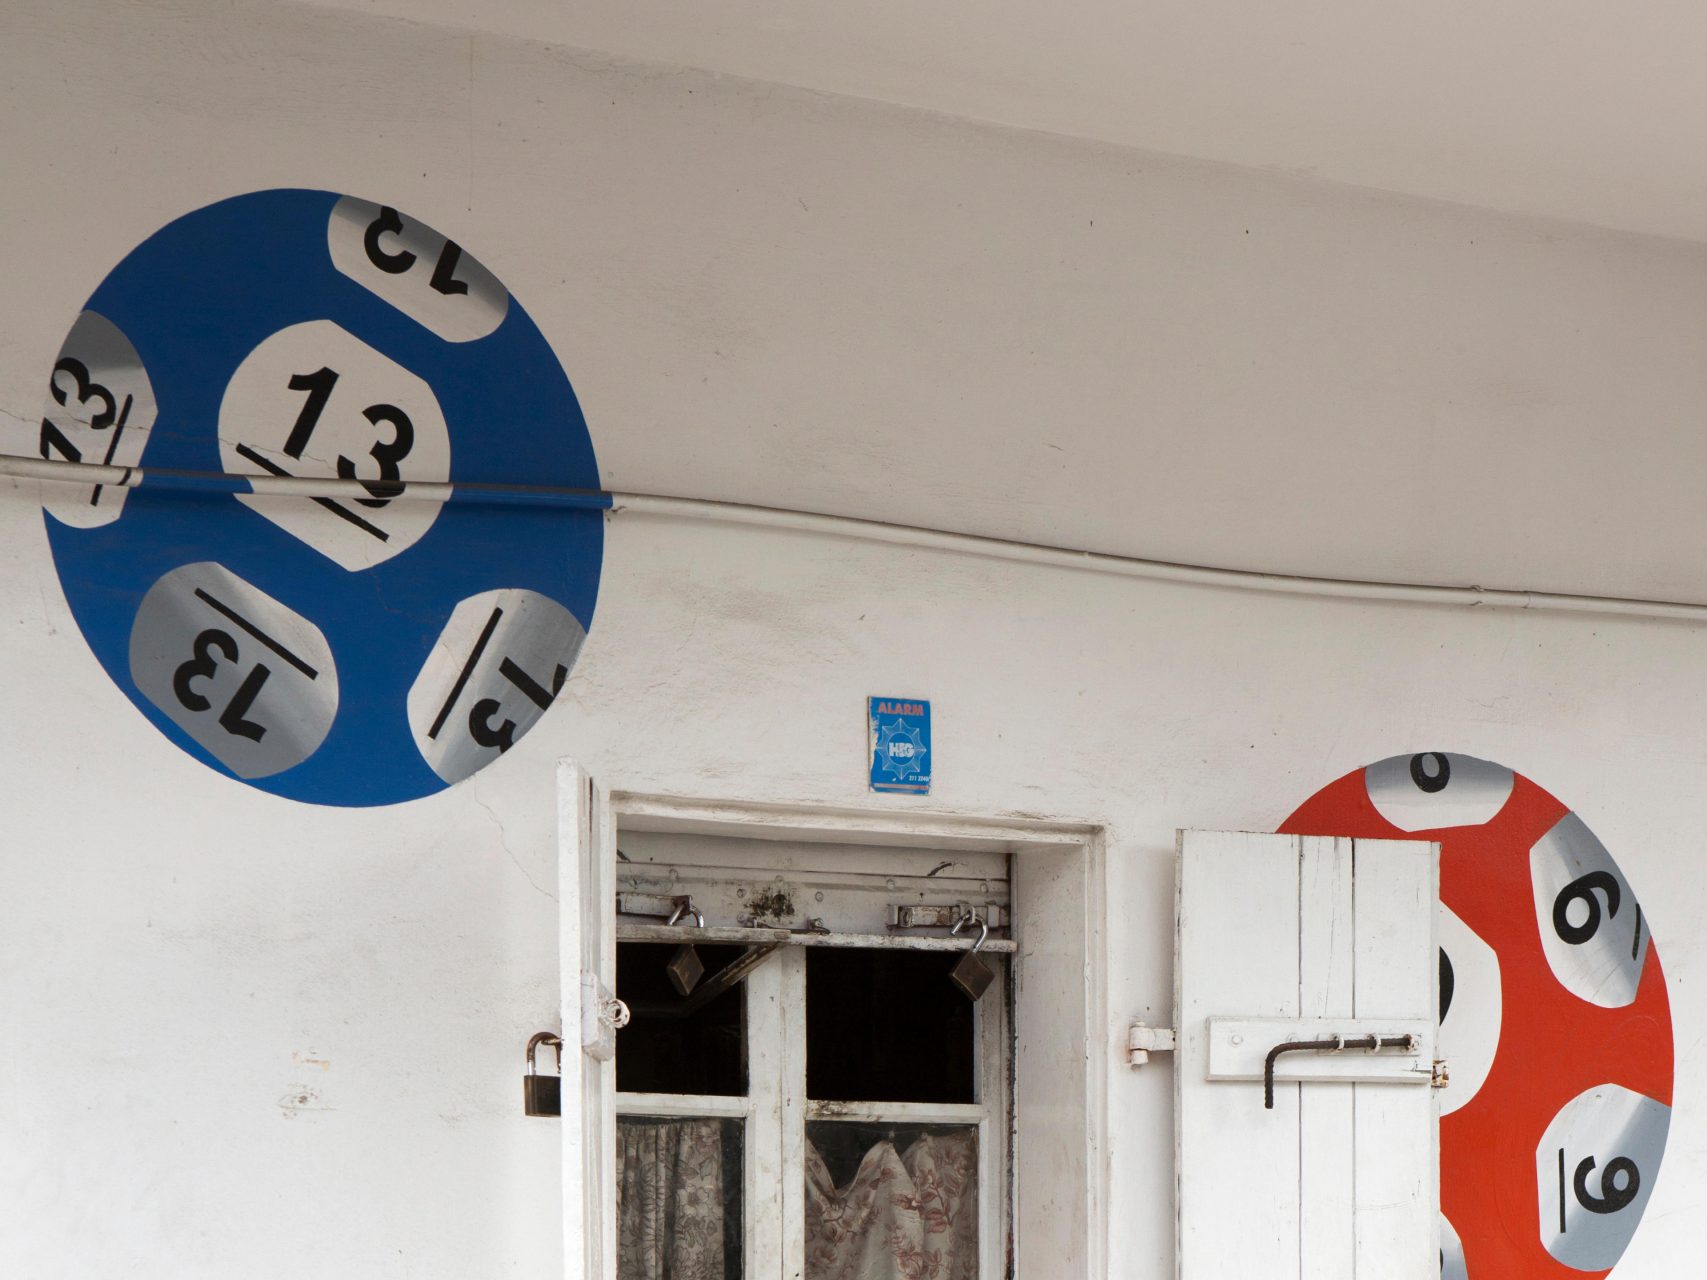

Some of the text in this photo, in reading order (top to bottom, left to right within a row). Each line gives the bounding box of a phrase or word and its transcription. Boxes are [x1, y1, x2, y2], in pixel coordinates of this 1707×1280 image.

[283, 366, 414, 508] 13
[172, 628, 272, 743] 13
[878, 702, 924, 716] ALARM
